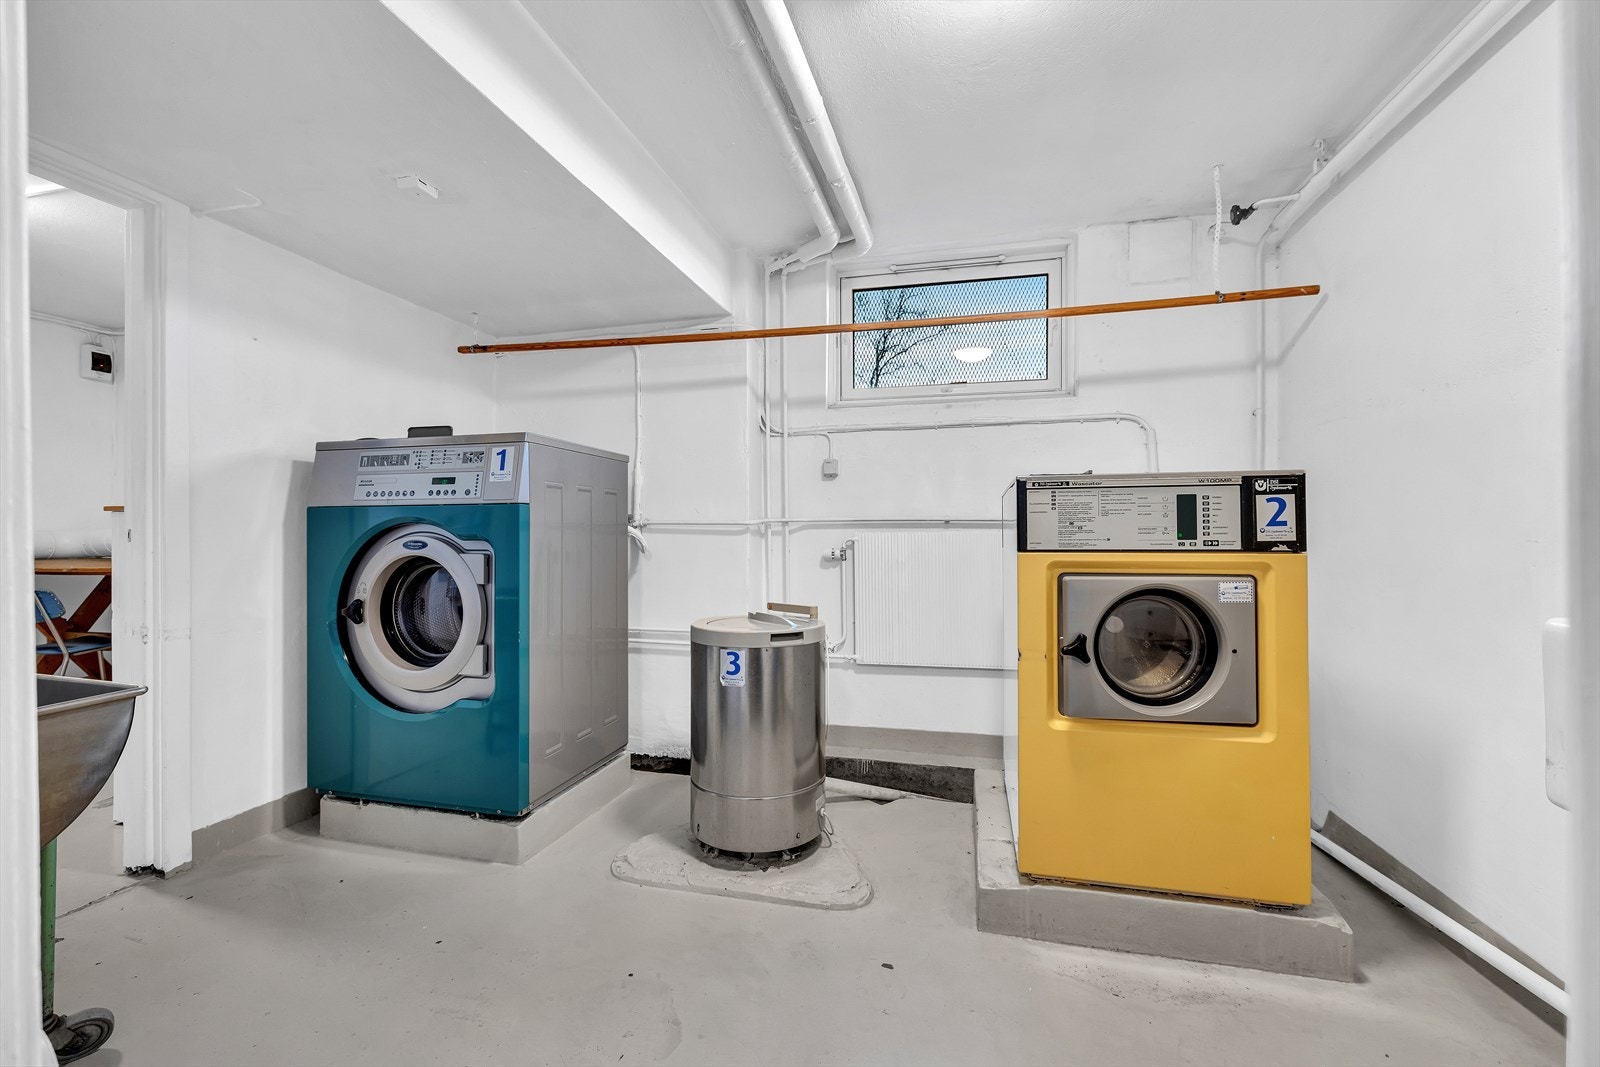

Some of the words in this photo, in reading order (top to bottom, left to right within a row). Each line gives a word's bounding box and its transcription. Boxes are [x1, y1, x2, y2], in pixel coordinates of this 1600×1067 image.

[496, 448, 507, 471] 1
[1265, 496, 1288, 527] 2
[725, 651, 741, 676] 3
